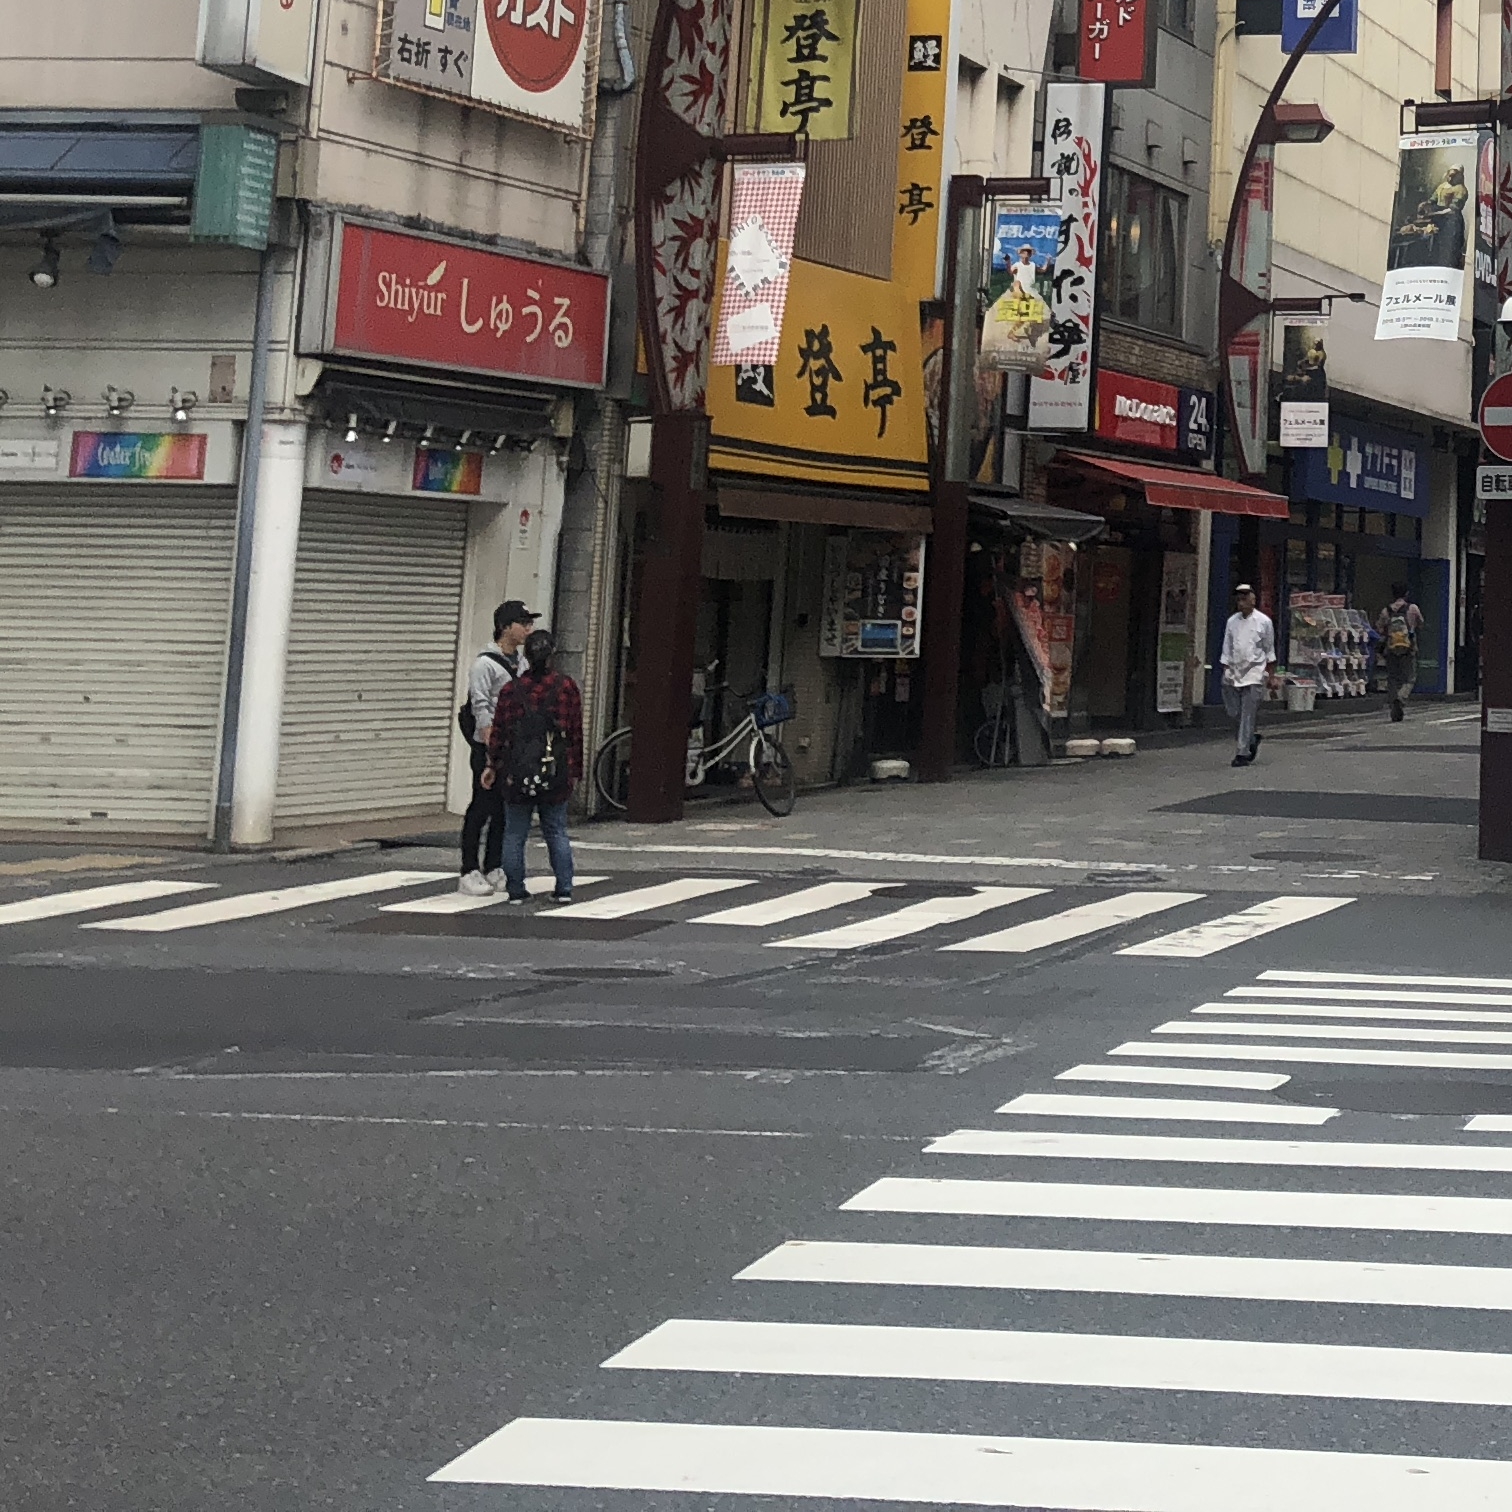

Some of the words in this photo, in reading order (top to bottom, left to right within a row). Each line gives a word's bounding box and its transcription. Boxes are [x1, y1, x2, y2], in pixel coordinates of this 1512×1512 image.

[397, 32, 432, 70] 右折
[438, 44, 469, 79] すぐ
[779, 10, 840, 135] 登亭
[459, 277, 575, 349] しゅうる
[1384, 292, 1458, 307] フェルメール展
[796, 323, 901, 438] 登亭
